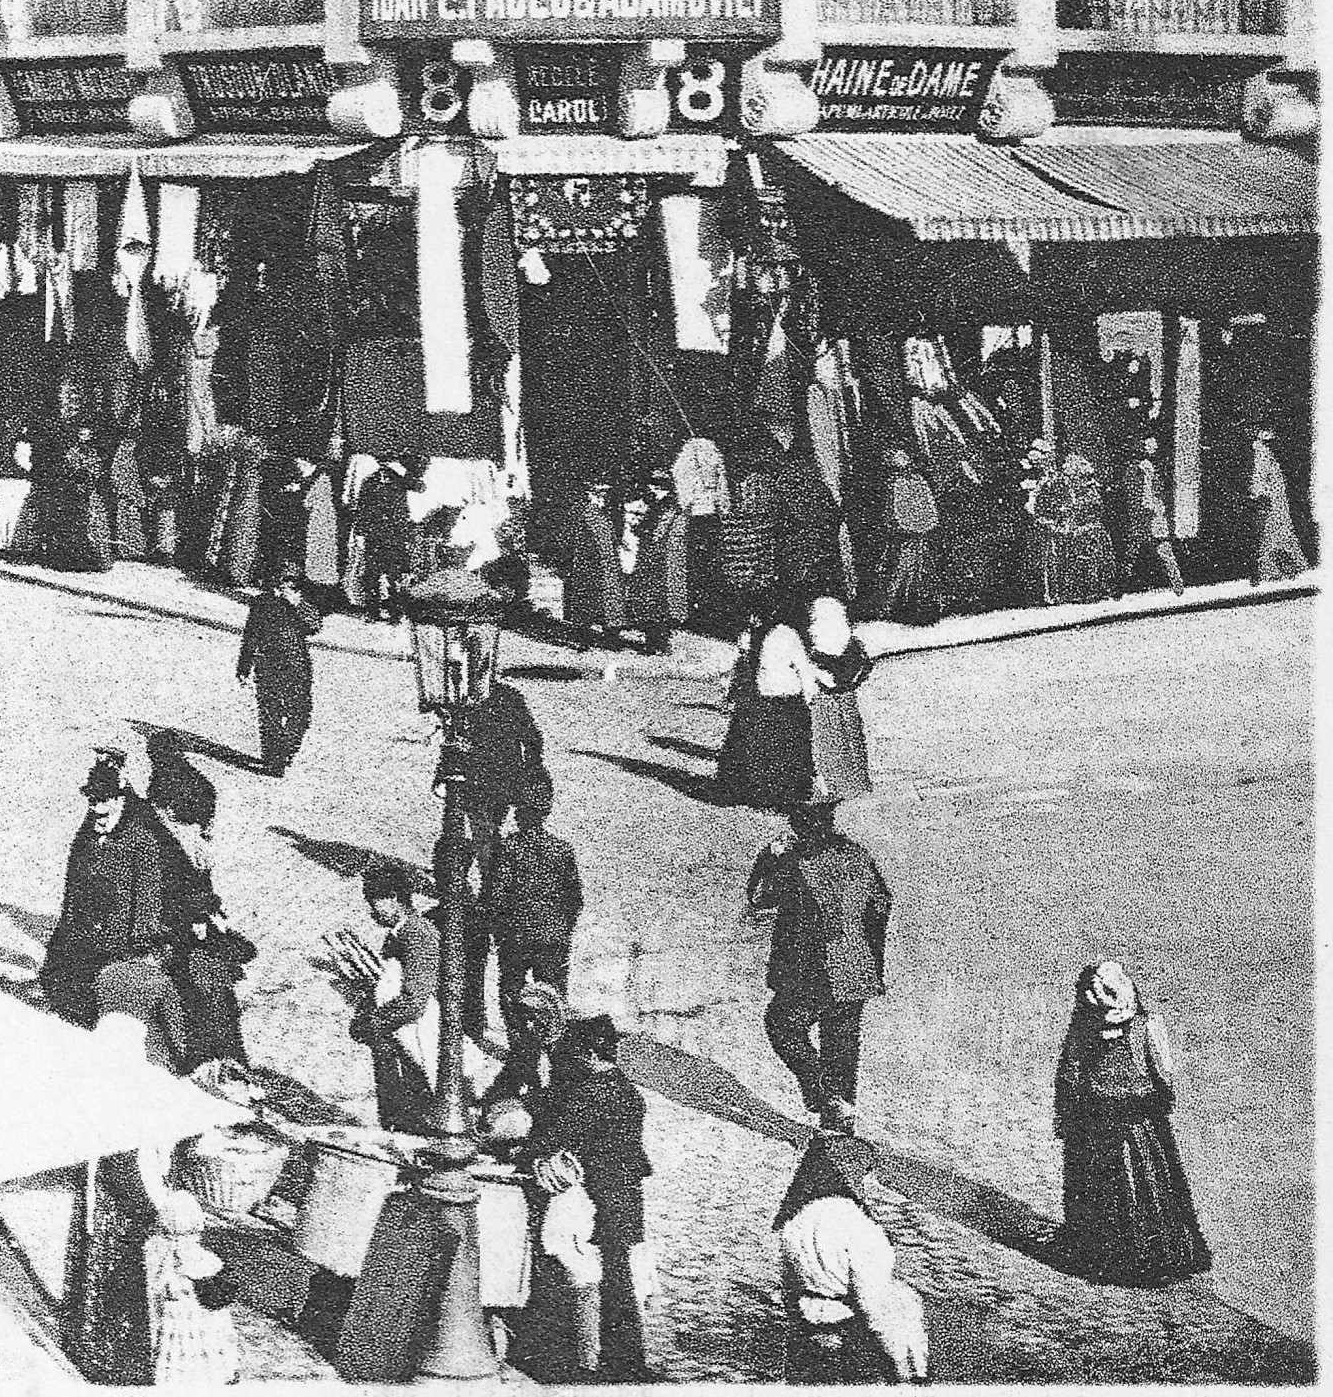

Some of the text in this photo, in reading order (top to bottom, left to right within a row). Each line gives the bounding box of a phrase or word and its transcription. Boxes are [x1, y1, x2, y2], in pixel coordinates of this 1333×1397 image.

[420, 60, 463, 122] 8
[678, 59, 727, 122] 8
[809, 58, 895, 97] HAINE
[906, 59, 983, 98] DAME
[528, 98, 598, 123] CAROL
